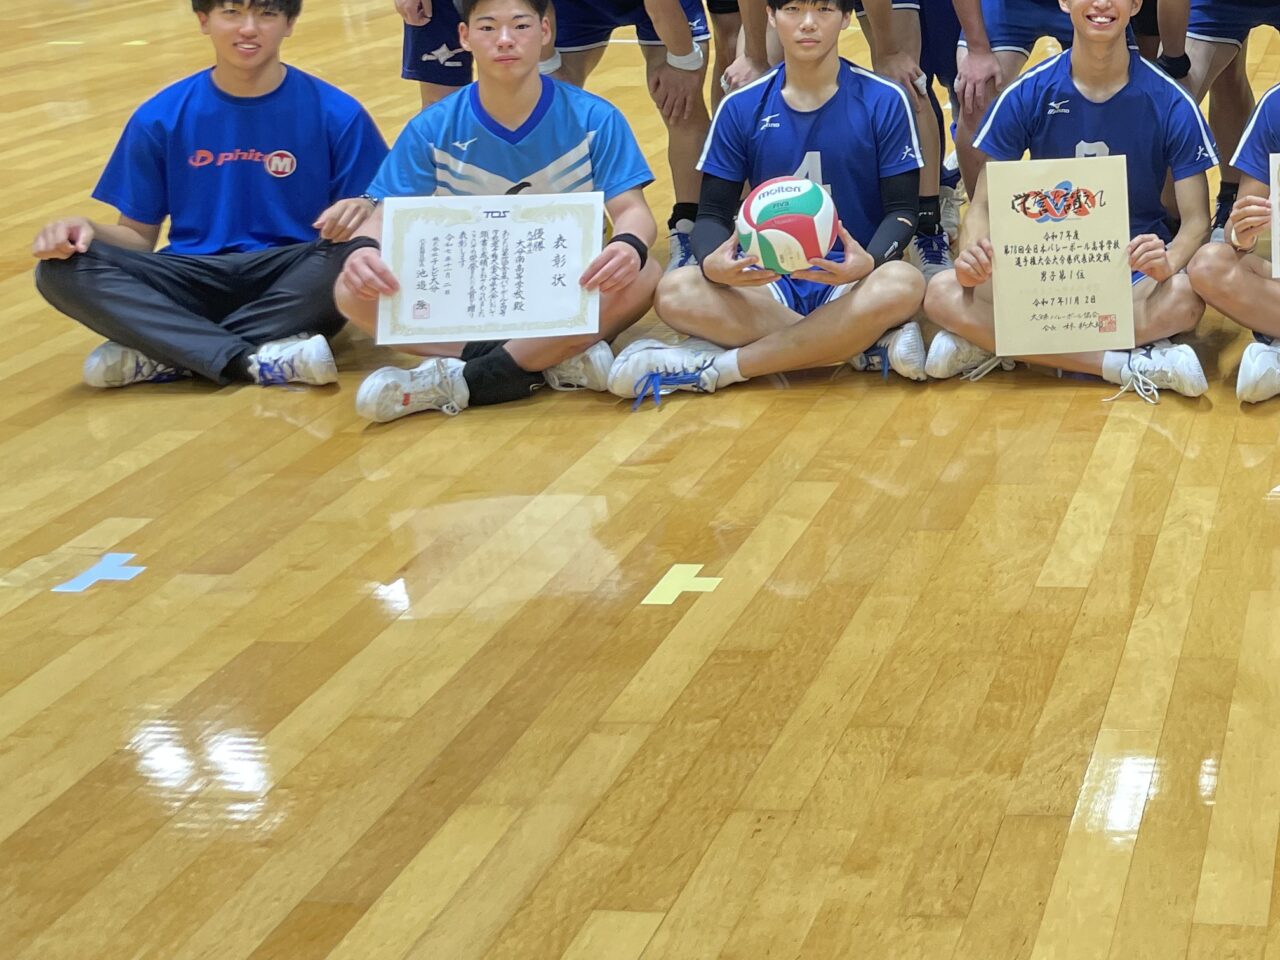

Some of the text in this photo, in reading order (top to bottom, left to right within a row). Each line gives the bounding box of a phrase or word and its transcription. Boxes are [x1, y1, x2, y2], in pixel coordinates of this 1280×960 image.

[271, 156, 292, 172] M
[758, 185, 801, 200] molten
[483, 210, 510, 218] TOS
[1043, 229, 1080, 241] 令和7年度
[551, 234, 567, 287] 表彰状
